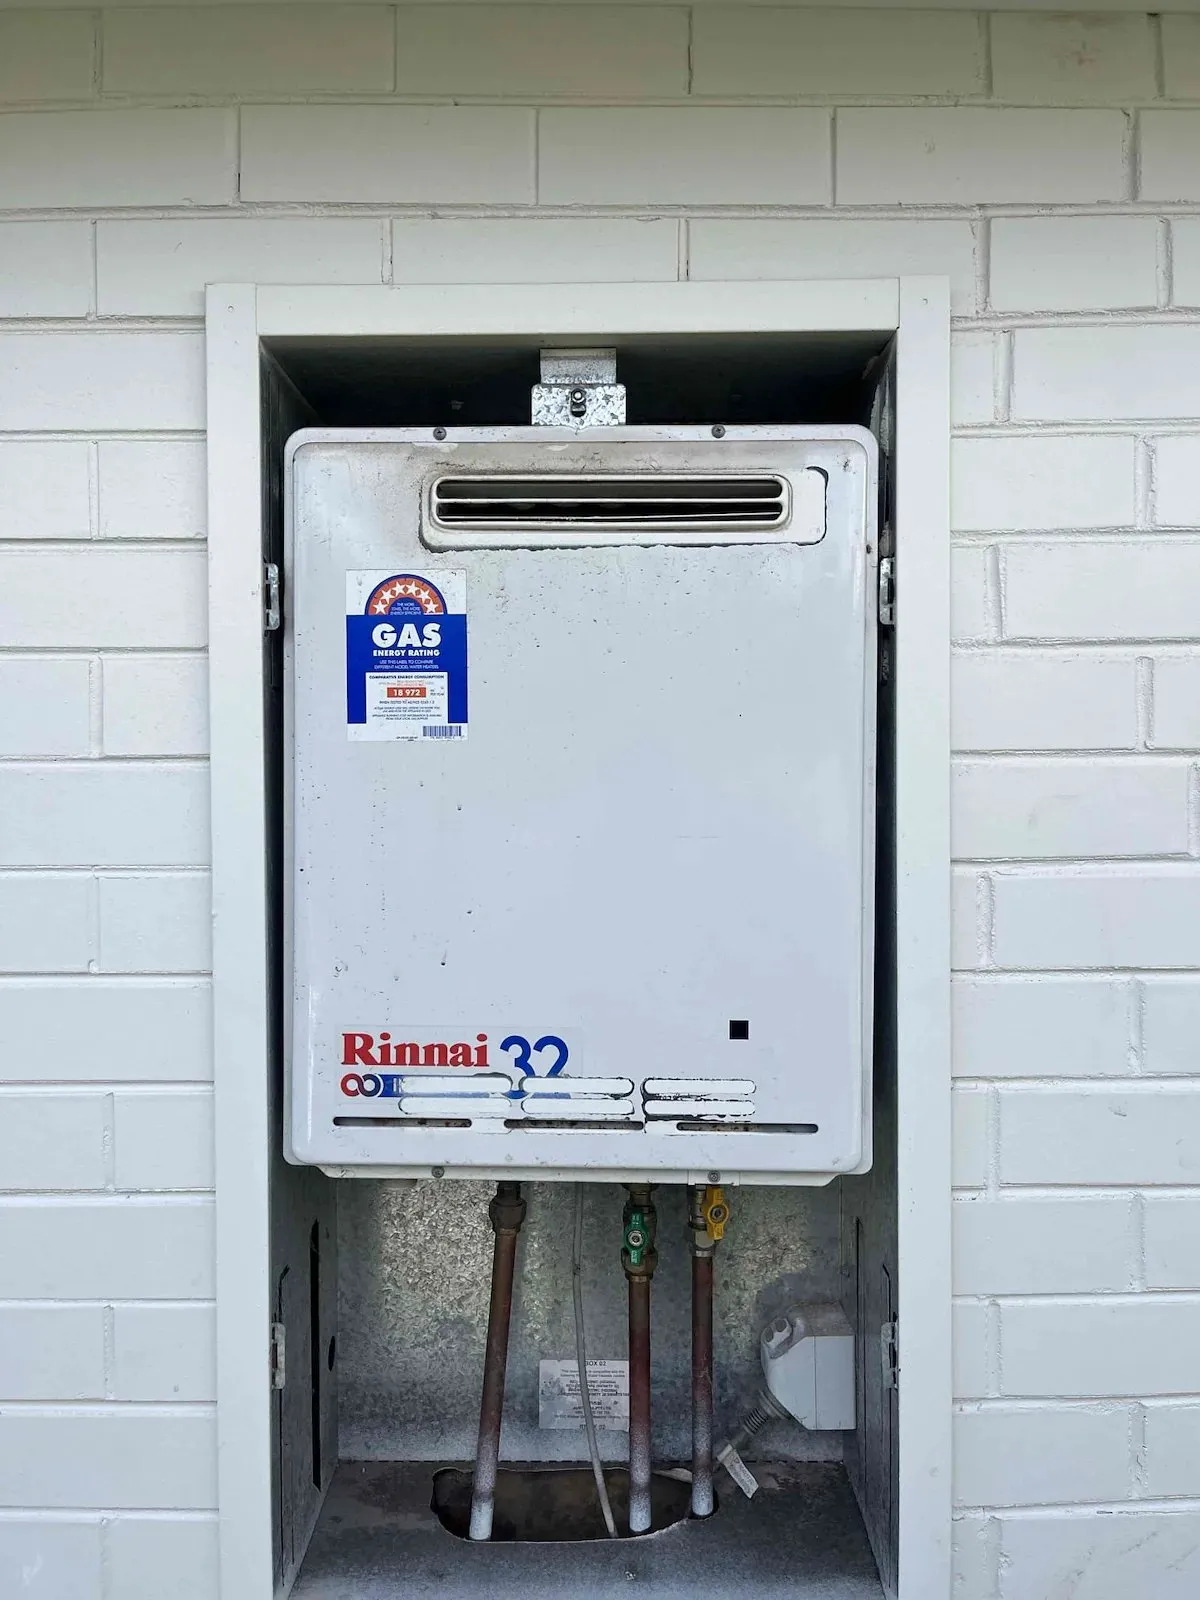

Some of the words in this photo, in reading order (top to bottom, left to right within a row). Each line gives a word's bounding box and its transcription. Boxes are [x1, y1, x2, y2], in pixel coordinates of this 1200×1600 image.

[372, 622, 441, 648] GAS
[372, 649, 406, 657] ENERGY
[407, 649, 440, 657] RATING
[341, 1032, 490, 1067] Rinnai
[500, 1035, 569, 1078] 32
